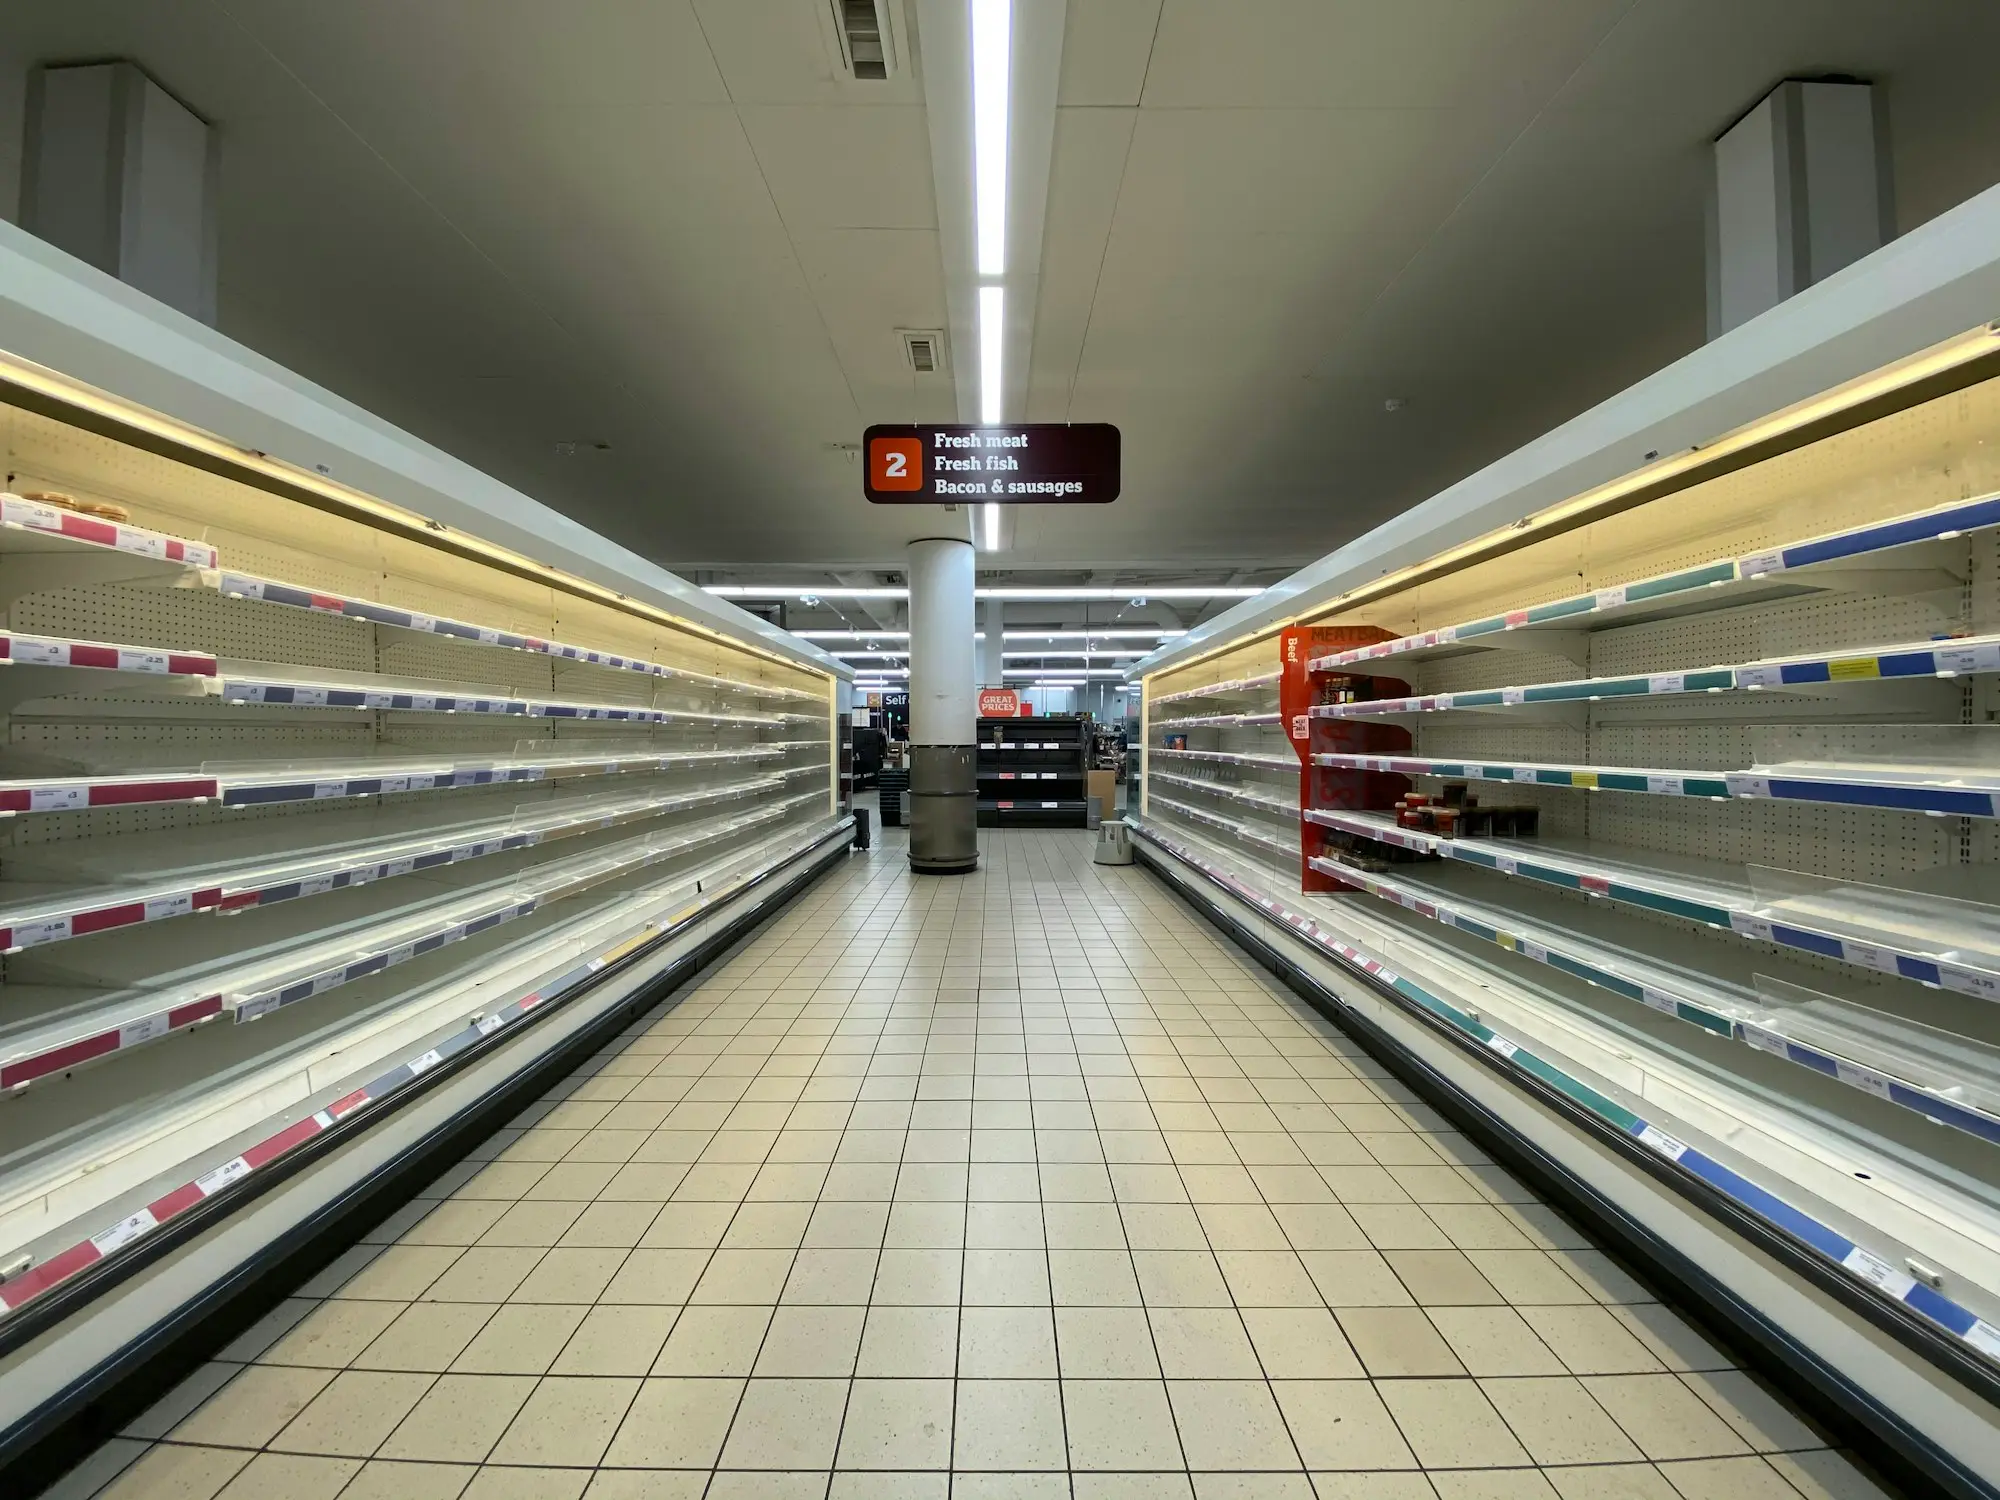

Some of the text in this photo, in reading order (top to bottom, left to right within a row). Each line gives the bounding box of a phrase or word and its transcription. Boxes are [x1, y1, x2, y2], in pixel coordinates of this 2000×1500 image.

[934, 433, 1028, 448] Fresh meat
[885, 452, 907, 477] 2
[934, 456, 1019, 471] Fresh fish
[934, 479, 1083, 496] Bacon & sausages
[1288, 637, 1298, 663] Beef
[885, 694, 907, 705] Self
[981, 703, 1015, 711] PRICES
[983, 696, 1013, 704] GREAT
